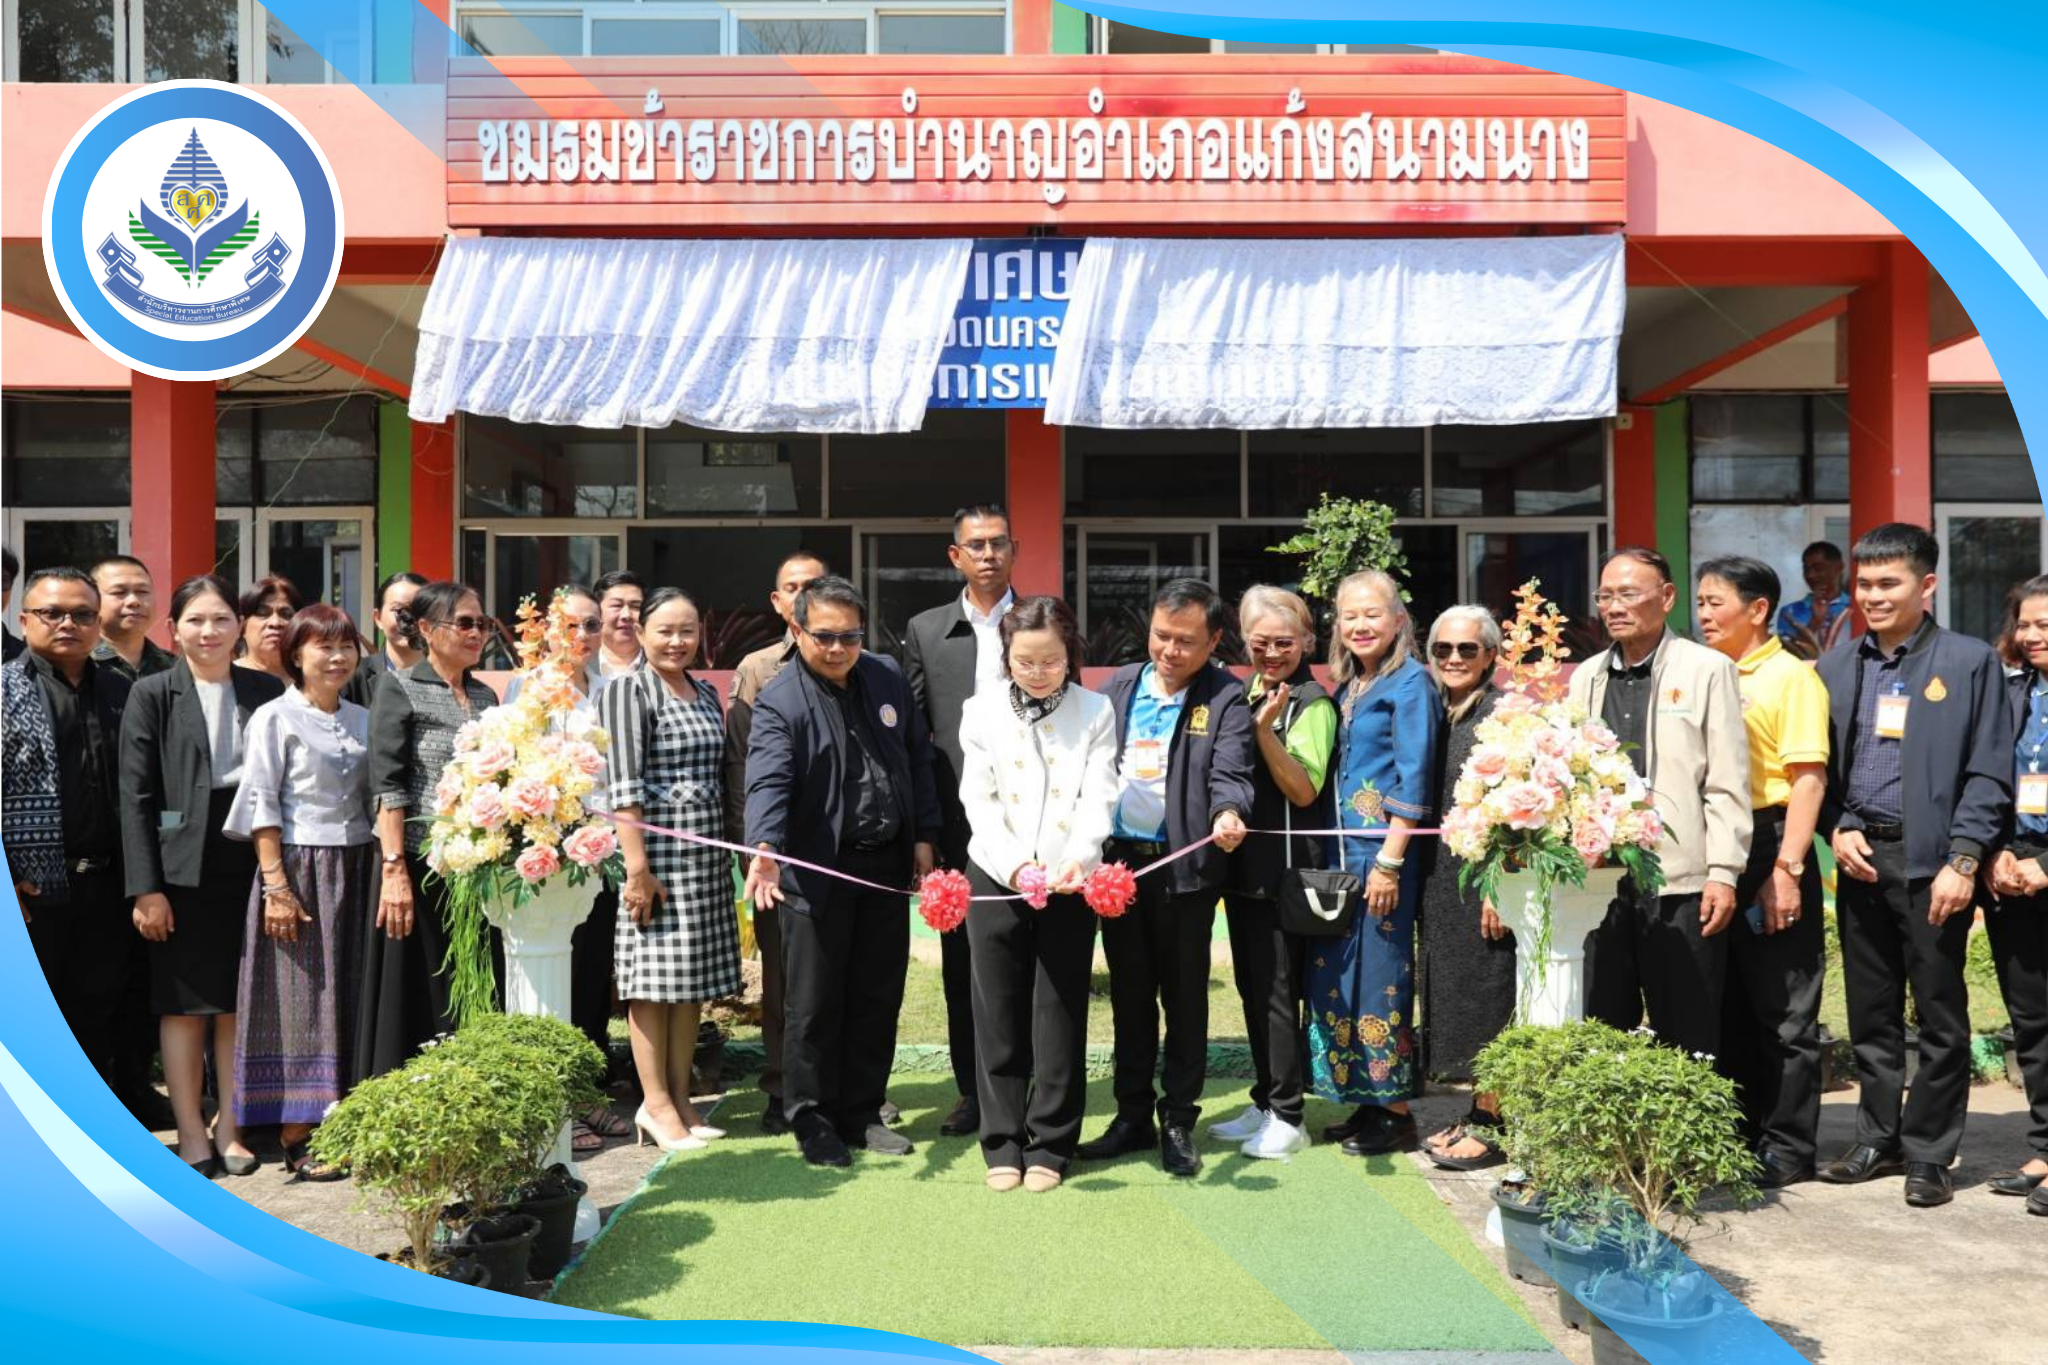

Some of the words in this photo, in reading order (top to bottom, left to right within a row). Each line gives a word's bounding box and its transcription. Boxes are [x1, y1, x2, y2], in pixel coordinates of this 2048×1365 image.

[478, 87, 1589, 204] ชมรมข้าราชการบำนาญอำเภอแก้งสนามนาง
